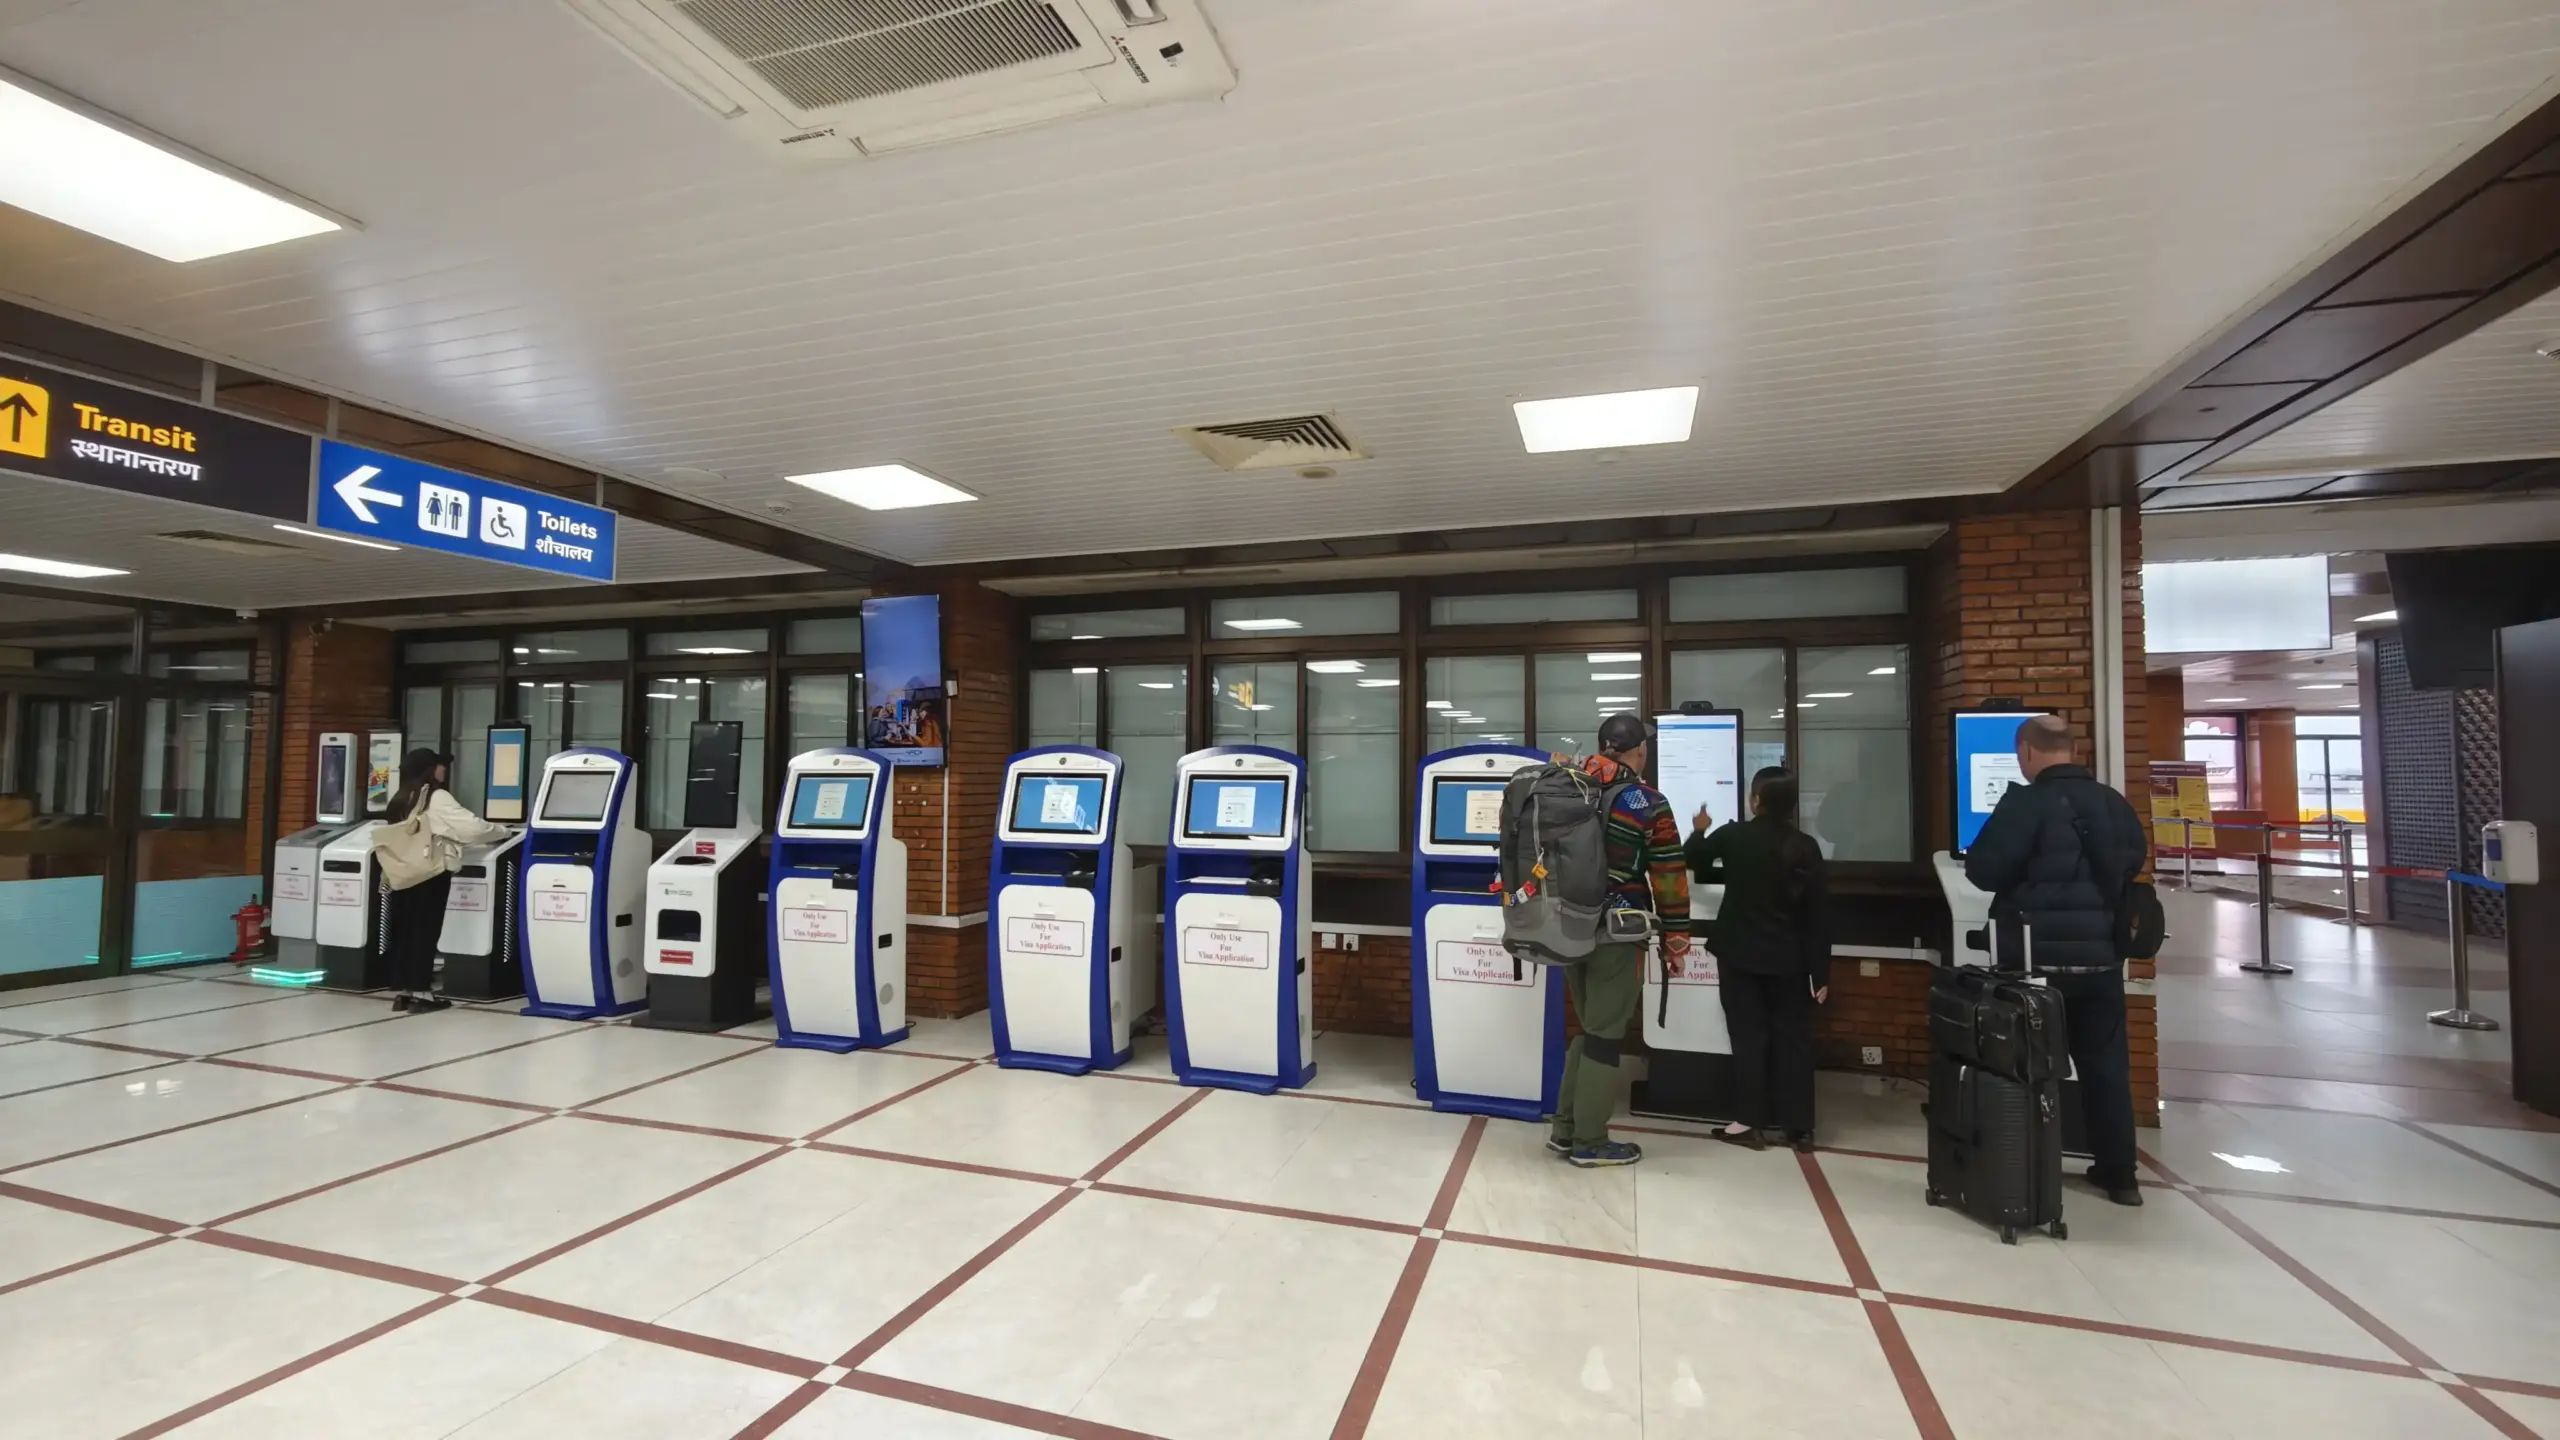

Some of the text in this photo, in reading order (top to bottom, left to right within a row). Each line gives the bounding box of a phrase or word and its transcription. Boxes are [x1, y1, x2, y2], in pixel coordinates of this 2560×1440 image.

[72, 402, 197, 453] Transit
[70, 438, 202, 481] स्थानान्तरण
[537, 510, 598, 539] Toilets
[535, 534, 594, 563] शौचालय
[1031, 922, 1046, 932] Only
[1210, 932, 1242, 942] Only Use
[1198, 951, 1254, 963] Visa Application
[1466, 946, 1486, 957] Only
[1488, 947, 1504, 957] Use
[1478, 959, 1492, 968] For
[1693, 960, 1709, 969] For
[1452, 966, 1514, 981] Visa Applicatio
[1687, 971, 1719, 981] Applic
